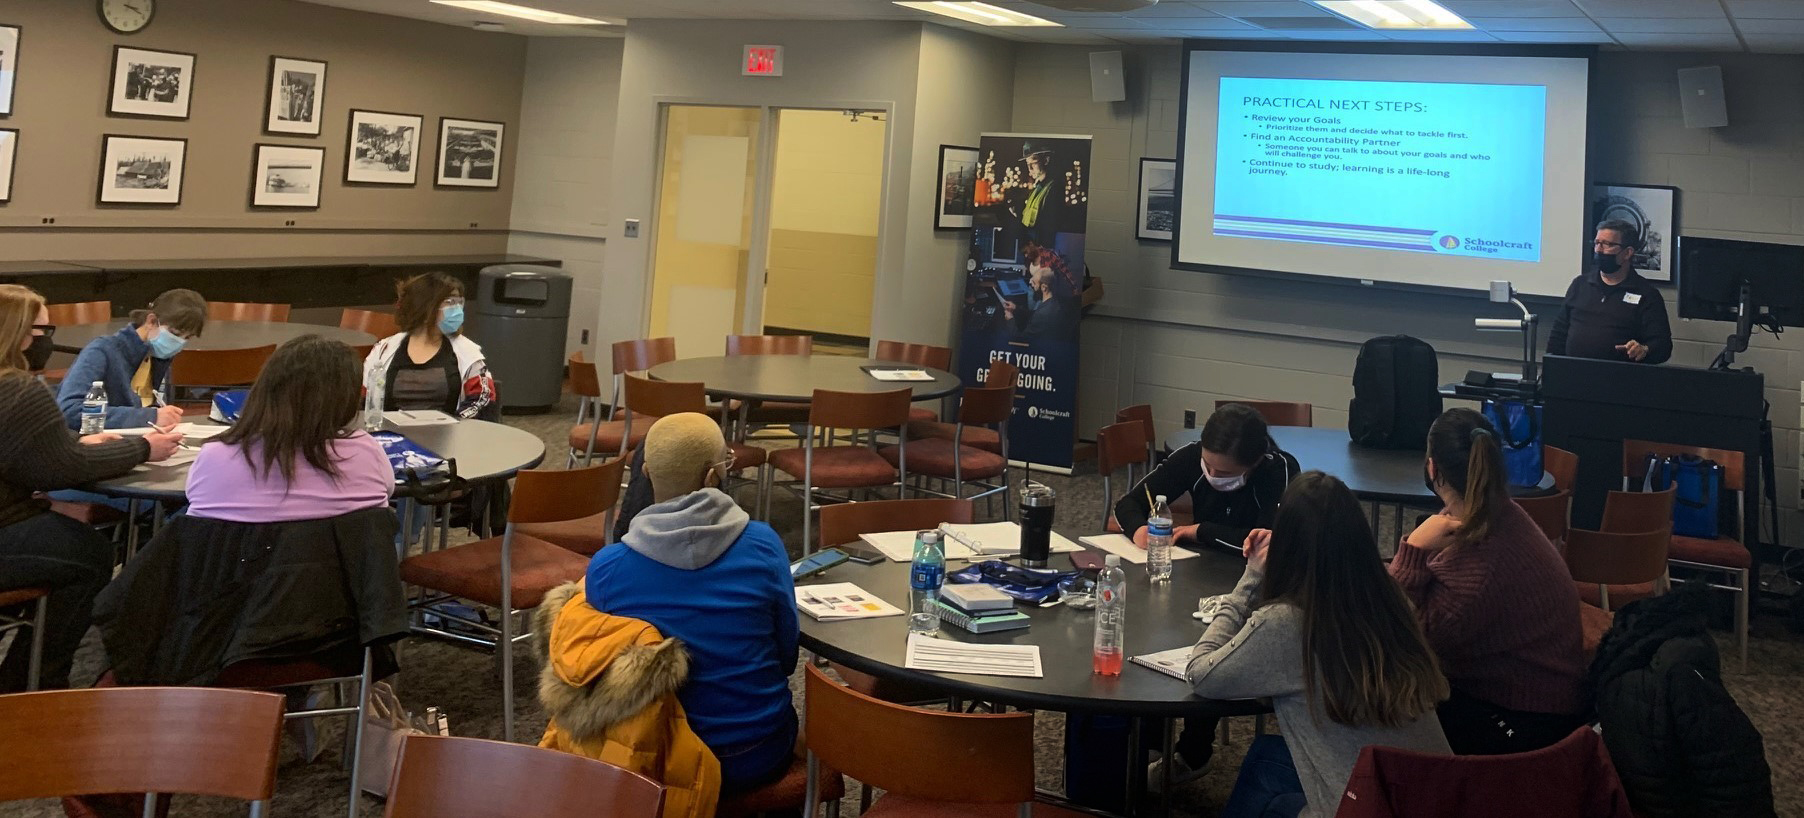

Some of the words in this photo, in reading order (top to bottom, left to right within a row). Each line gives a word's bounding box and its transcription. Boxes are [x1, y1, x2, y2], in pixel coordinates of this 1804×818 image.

[747, 48, 776, 72] EXIT
[1243, 96, 1325, 109] PRACTICAL
[1329, 99, 1371, 111] NEXT
[1374, 101, 1428, 113] STEPS:
[1251, 114, 1286, 122] Review
[1305, 125, 1328, 133] them
[1349, 127, 1379, 135] decide
[1447, 131, 1469, 139] first.
[1250, 133, 1271, 141] Find
[1288, 135, 1360, 146] Accountability
[1362, 138, 1401, 147] Partner
[1265, 143, 1305, 151] Someone
[1372, 148, 1399, 156] about
[1423, 151, 1447, 159] goals
[1449, 152, 1468, 160] and
[1281, 151, 1322, 159] challenge
[1248, 167, 1288, 176] journey.
[1249, 159, 1293, 168] Continue
[1296, 161, 1307, 169] to
[1308, 161, 1339, 172] study;
[1342, 164, 1384, 174] learning
[1386, 166, 1395, 174] is
[1406, 167, 1451, 178] life-long
[1464, 238, 1533, 250] Schoolcraft
[1464, 245, 1498, 253] College
[1015, 353, 1046, 371] YOUR
[1017, 373, 1056, 392] GOING.
[1040, 408, 1070, 418] Schoolcraft
